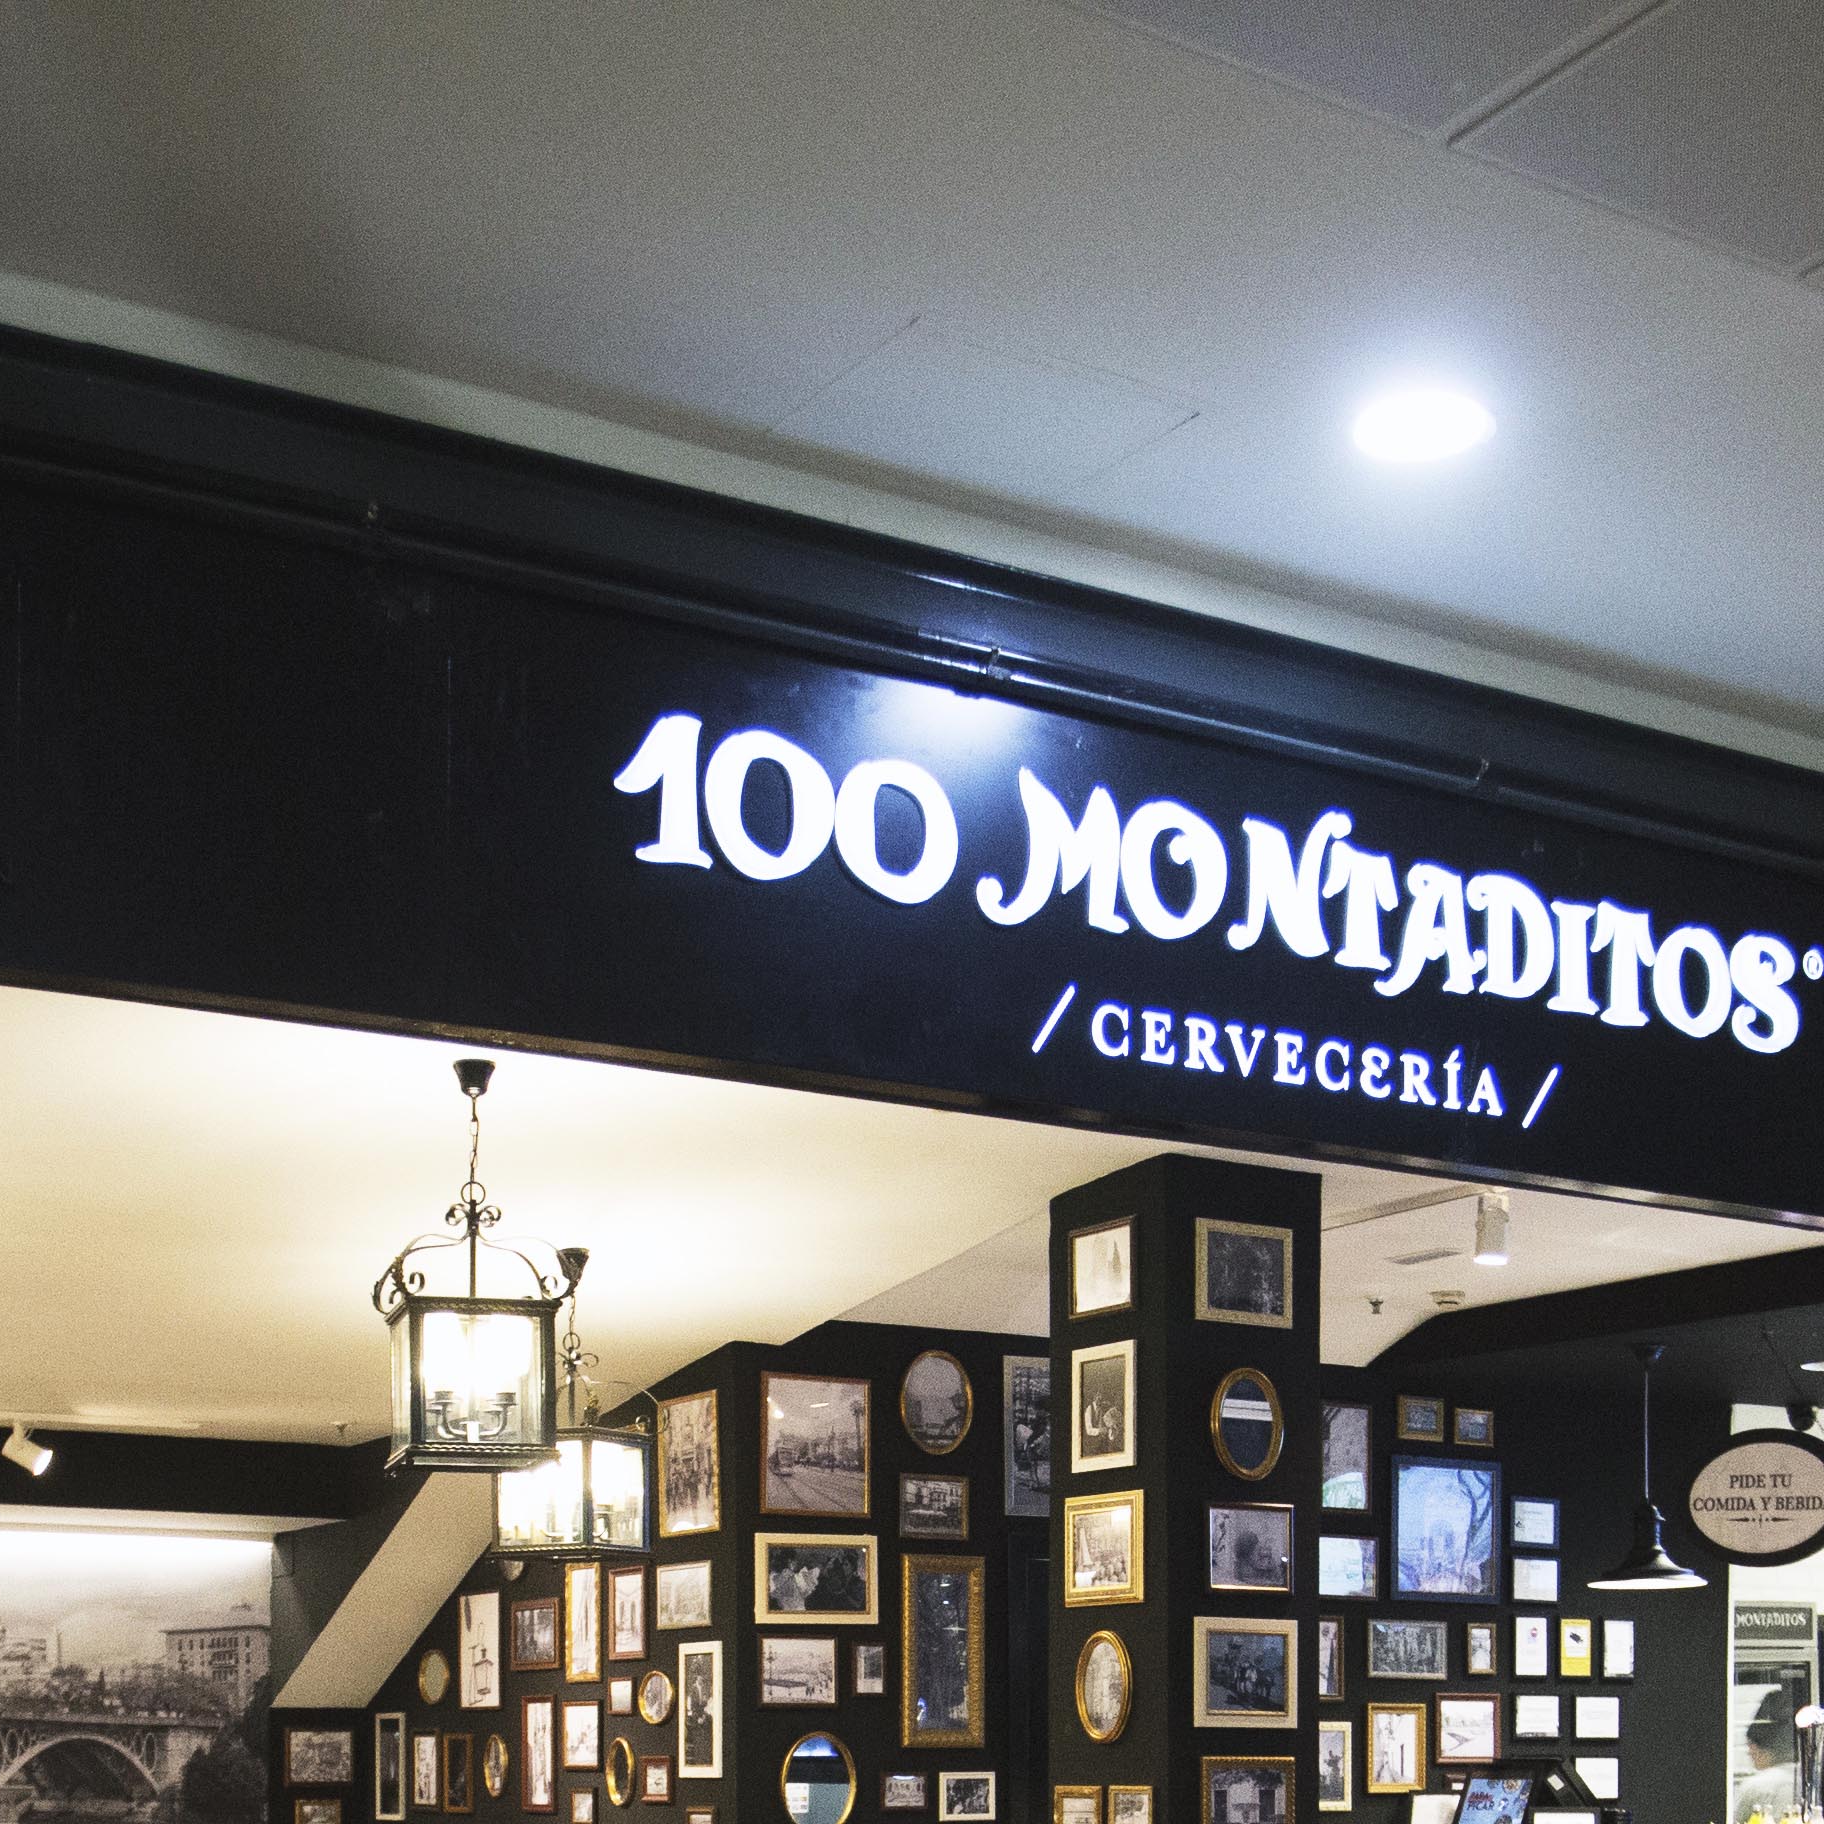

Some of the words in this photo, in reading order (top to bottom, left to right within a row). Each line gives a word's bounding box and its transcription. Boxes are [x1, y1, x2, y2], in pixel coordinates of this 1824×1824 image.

[613, 712, 960, 906] 100
[1091, 1003, 1504, 1118] CERVECERÍA
[1729, 1474, 1766, 1489] PIDE
[1769, 1473, 1793, 1488] TU
[1693, 1497, 1756, 1512] COMIDA
[1760, 1496, 1772, 1511] Y
[1734, 1611, 1807, 1629] MONTADITOS
